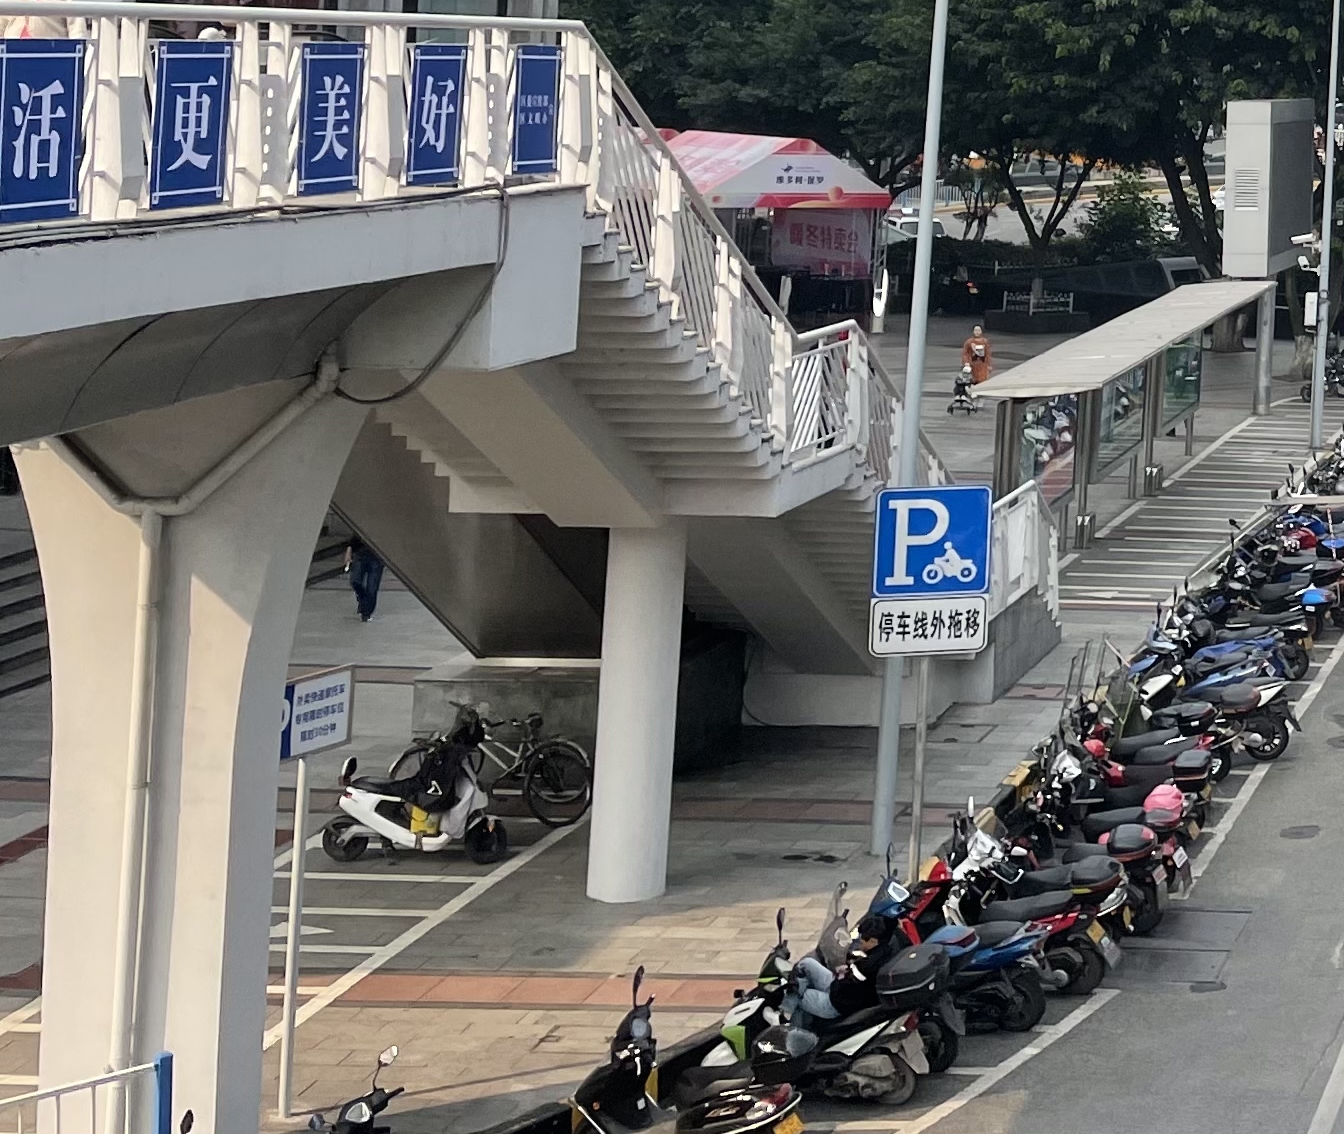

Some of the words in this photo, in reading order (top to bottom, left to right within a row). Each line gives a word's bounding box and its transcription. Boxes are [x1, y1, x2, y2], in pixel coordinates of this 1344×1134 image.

[12, 79, 66, 180] 活
[166, 75, 218, 171] 更
[311, 74, 350, 162] 美
[419, 75, 455, 153] 好
[884, 499, 950, 587] P
[879, 609, 980, 643] 停车线外拖移
